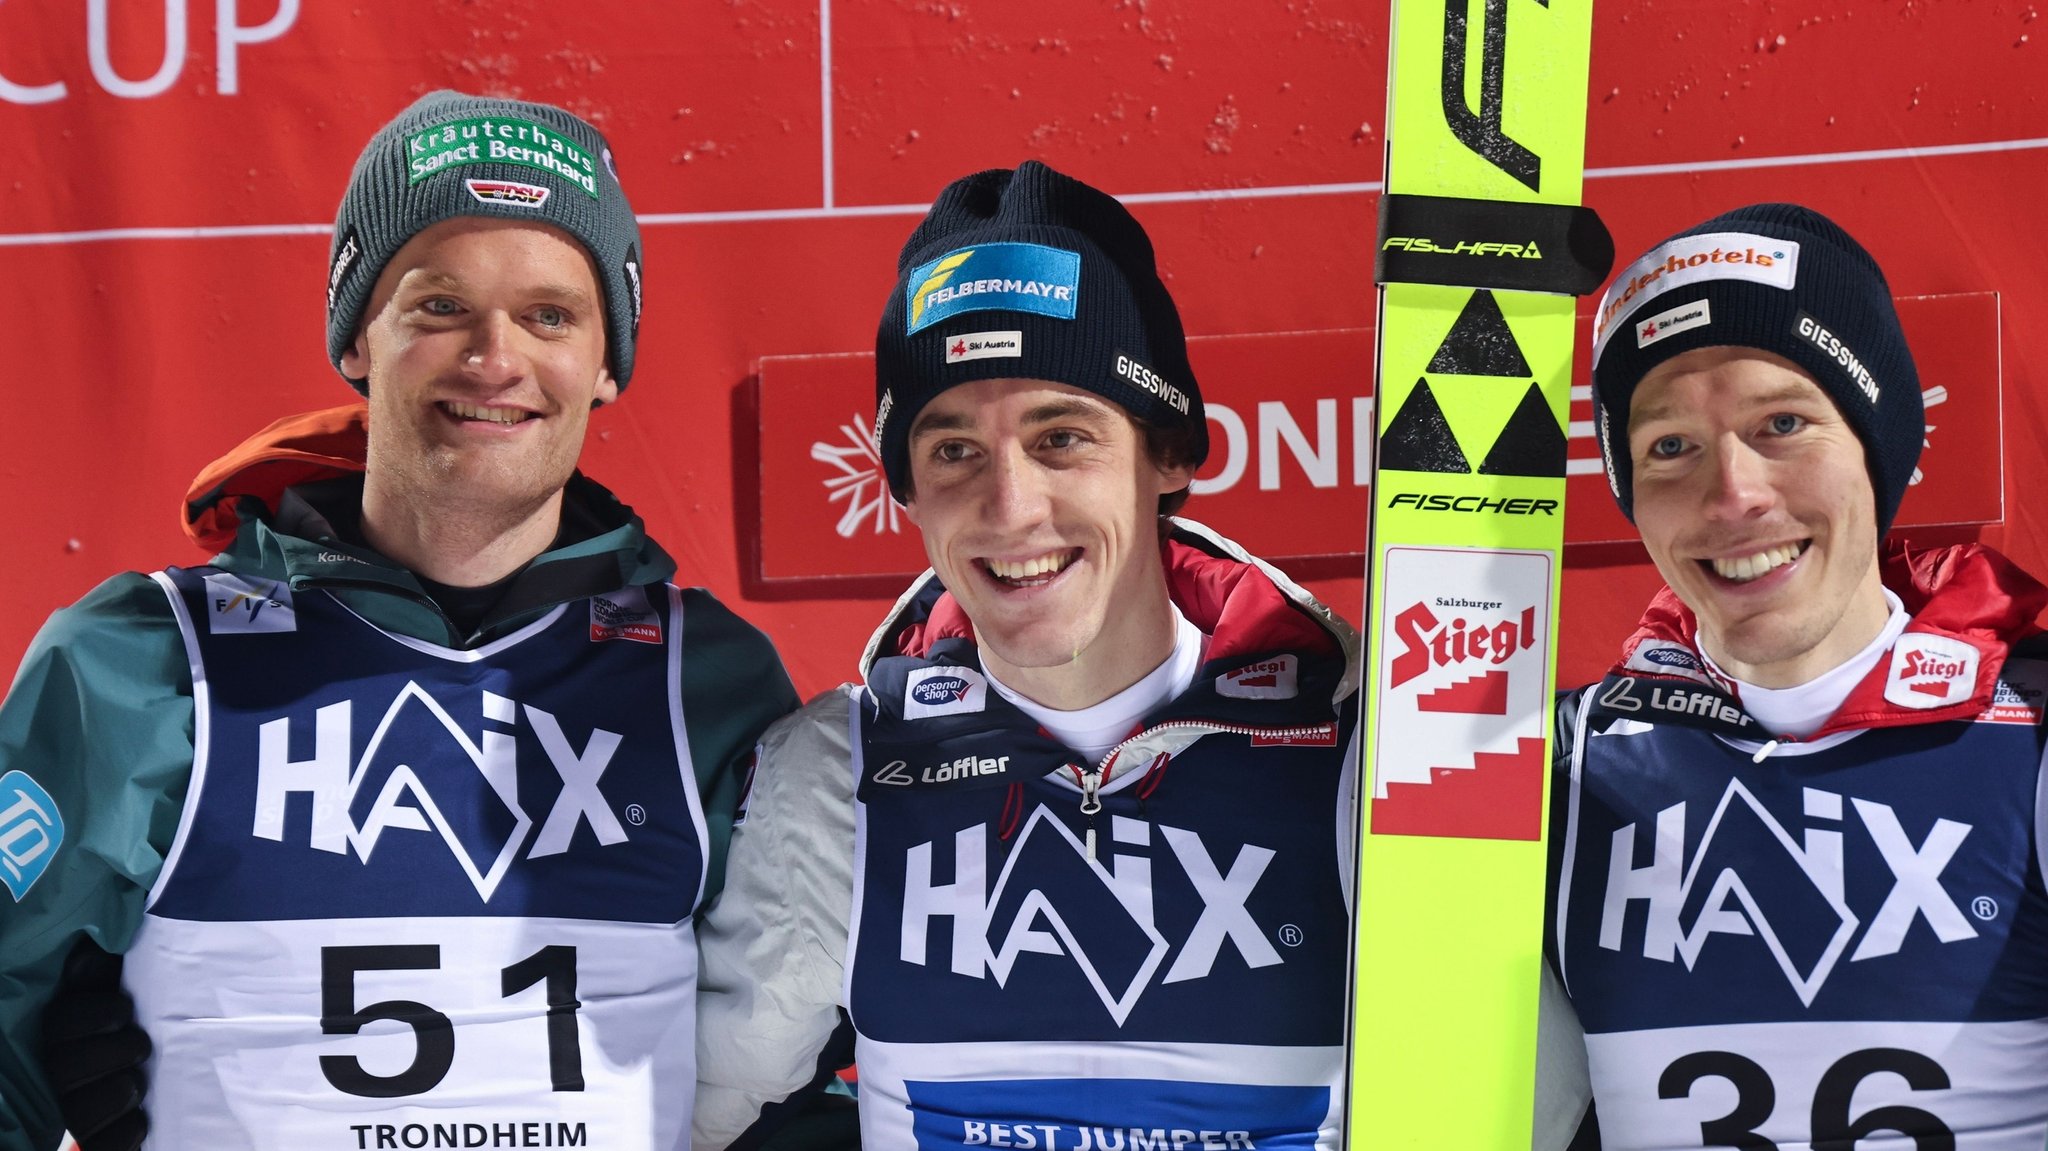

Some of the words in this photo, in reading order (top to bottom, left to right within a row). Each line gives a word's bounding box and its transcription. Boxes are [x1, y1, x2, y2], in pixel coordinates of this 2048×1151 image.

[0, 0, 299, 102] UP
[410, 121, 592, 173] Kräuterhaus
[412, 141, 480, 180] Sanct
[489, 139, 594, 194] Bernhard
[927, 279, 1072, 309] FELBERMAYR
[1658, 319, 1672, 330] Ski
[1673, 310, 1703, 325] Austria
[969, 341, 983, 351] Ski
[984, 340, 1016, 350] Austria
[1799, 317, 1880, 404] GIESSWEIN
[1116, 355, 1190, 416] GIESSWEIN
[1388, 493, 1559, 516] FISCHER
[1435, 597, 1504, 611] Salzburger
[1390, 601, 1537, 690] Stiegl
[1658, 655, 1691, 665] shop
[1900, 649, 1967, 680] Stiegl
[915, 680, 962, 696] personal
[924, 689, 949, 701] shop
[1651, 688, 1755, 727] Löffler
[921, 755, 1010, 783] Löffler
[319, 943, 586, 1098] 51
[1657, 1046, 1957, 1151] 36
[349, 1122, 588, 1150] TRONDHEIM
[962, 1119, 1062, 1151] BEST
[1073, 1125, 1257, 1151] JUMPER
